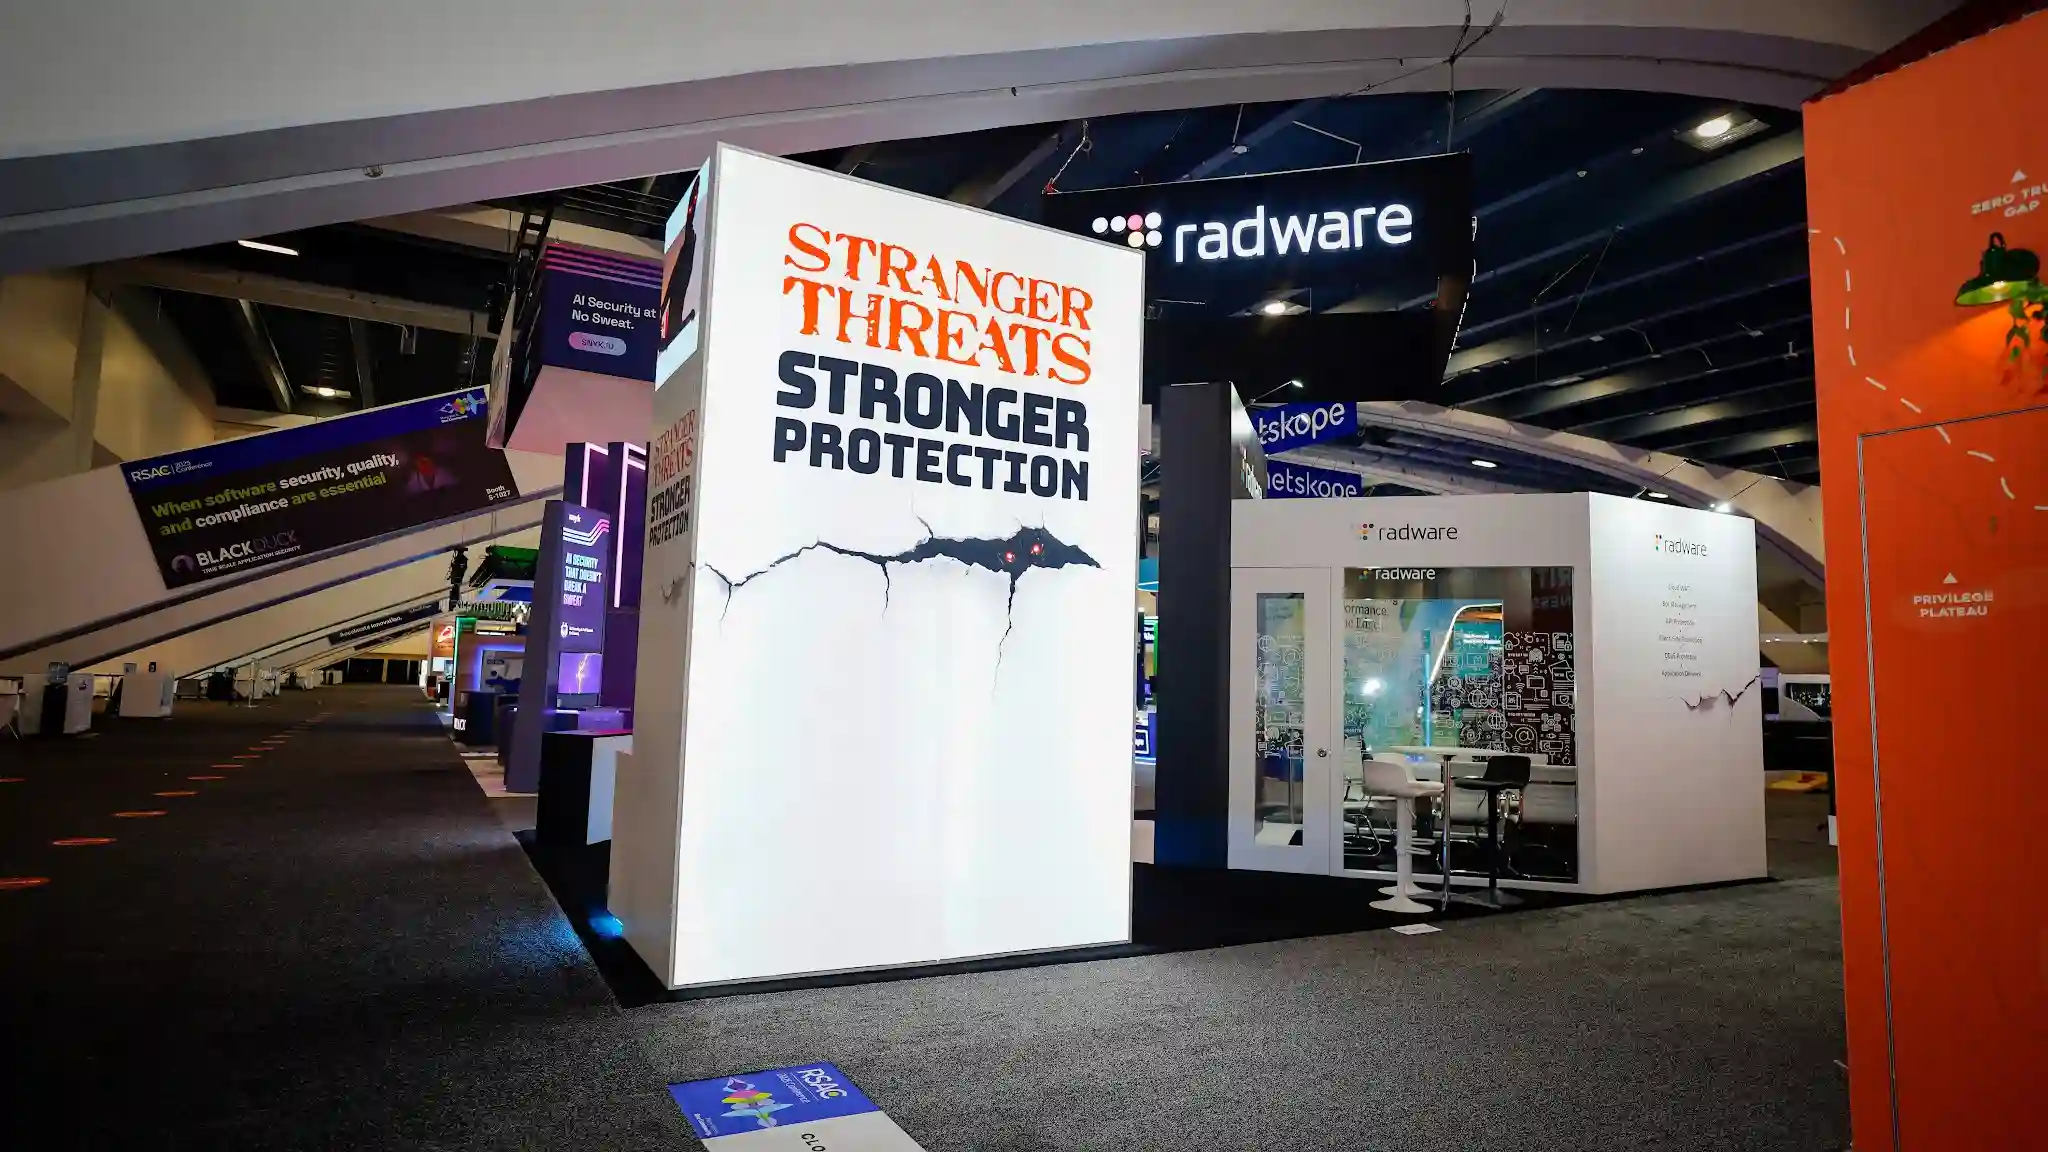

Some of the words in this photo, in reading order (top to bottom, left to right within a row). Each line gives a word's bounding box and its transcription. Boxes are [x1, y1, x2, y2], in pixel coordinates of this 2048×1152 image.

[1971, 194, 2015, 215] ZERO
[2004, 200, 2040, 217] GAP
[1175, 203, 1413, 263] radware
[784, 222, 1094, 330] STRANGER
[573, 294, 585, 306] AI
[588, 297, 640, 318] Security
[644, 309, 656, 318] at
[572, 310, 589, 323] No
[592, 313, 635, 330] Sweat.
[783, 276, 1091, 385] THREATS
[776, 350, 1090, 452] STRONGER
[654, 409, 696, 459] STRANGER
[175, 461, 213, 474] Conference
[652, 437, 693, 488] THREATS
[773, 416, 1089, 501] PROTECTION
[131, 465, 171, 482] RSAC
[152, 498, 202, 517] When
[205, 481, 276, 506] software
[280, 466, 345, 489] security,
[346, 453, 400, 476] quality,
[486, 485, 505, 495] Booth
[650, 475, 691, 523] STRONGER
[160, 517, 192, 536] and
[196, 497, 289, 528] compliance
[292, 491, 317, 505] are
[320, 471, 386, 498] essential
[649, 508, 689, 548] PROTECTION
[1379, 524, 1458, 540] radware
[238, 552, 274, 566] APPLICATION
[274, 545, 301, 556] SECURITY
[1664, 538, 1708, 556] radware
[1375, 568, 1436, 580] radware
[1914, 590, 1993, 605] PRIVILEGE
[1920, 606, 1988, 617] PLATEAU
[798, 1068, 847, 1099] RSAC
